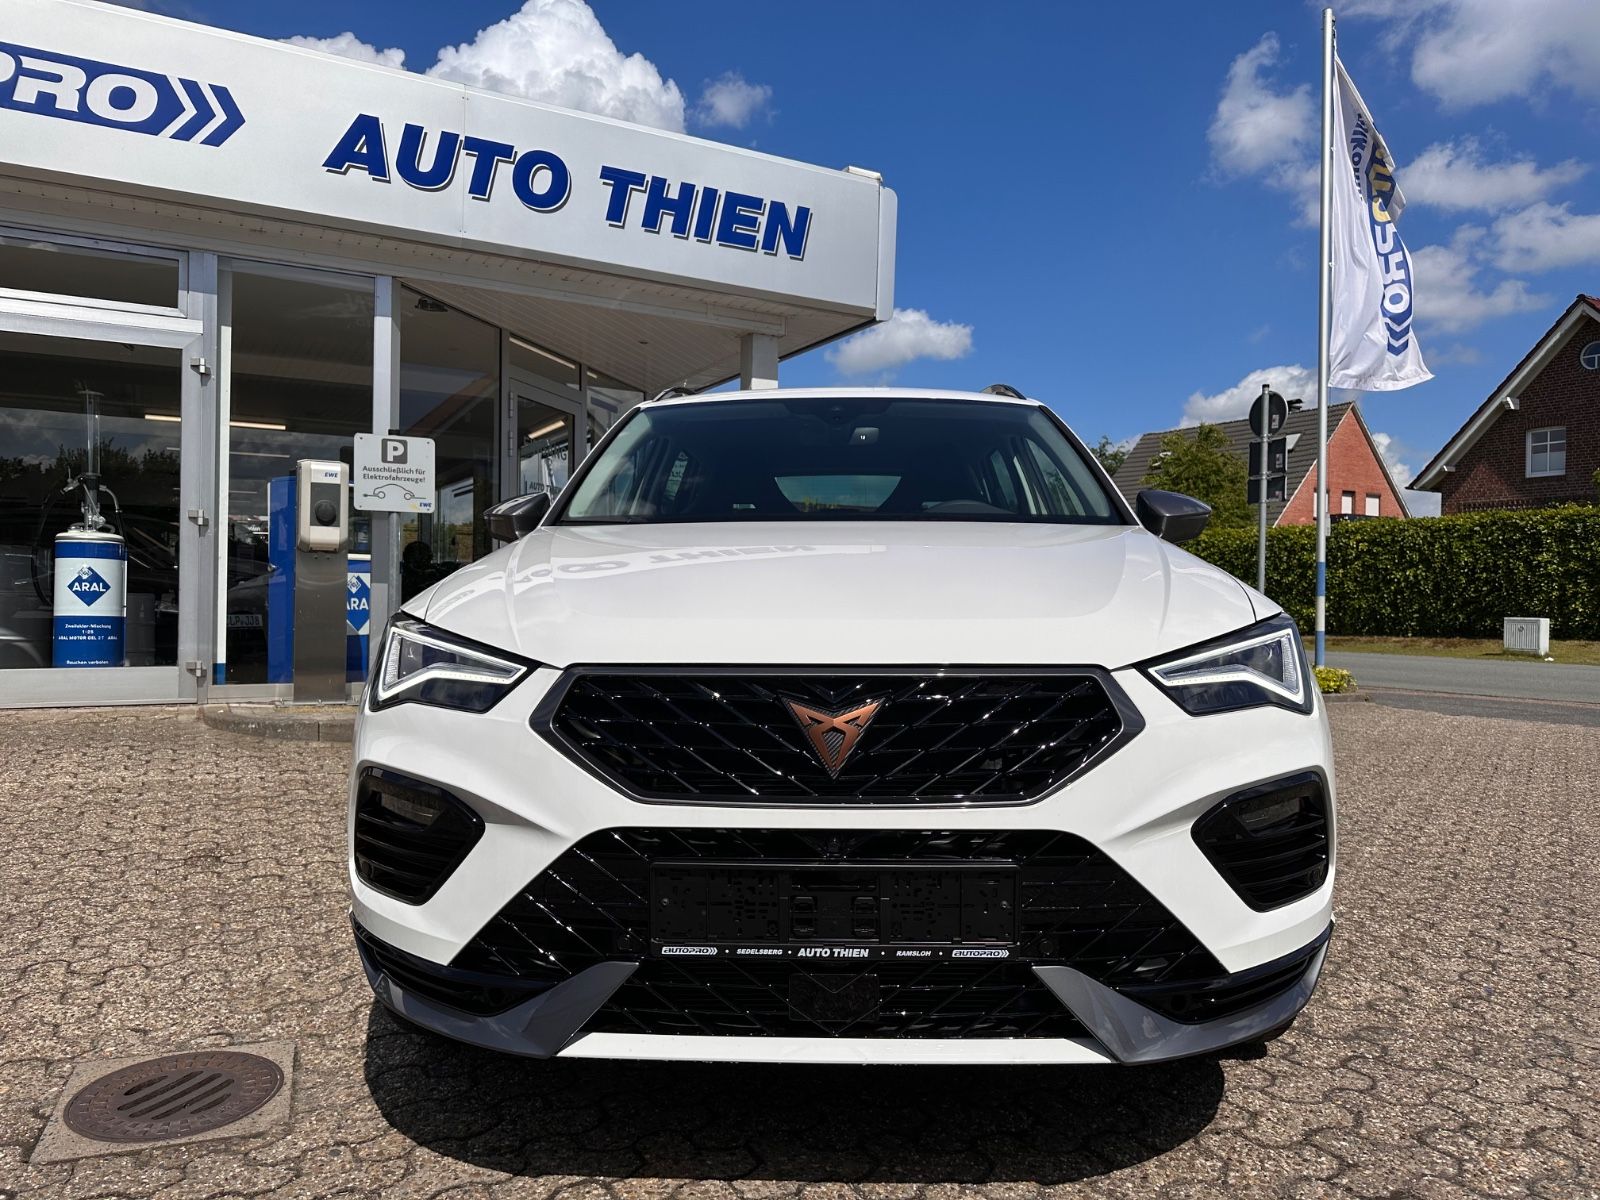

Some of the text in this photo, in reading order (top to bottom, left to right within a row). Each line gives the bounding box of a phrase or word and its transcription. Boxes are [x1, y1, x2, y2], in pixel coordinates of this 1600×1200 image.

[0, 51, 158, 123] RO
[322, 113, 812, 260] AUTO THIEN
[387, 441, 405, 462] P
[362, 466, 414, 474] Ausschließlich
[362, 473, 426, 483] Elektrofahrzeuge!
[72, 582, 106, 592] ARAL
[797, 947, 830, 957] AUTO
[832, 948, 869, 958] THIEN
